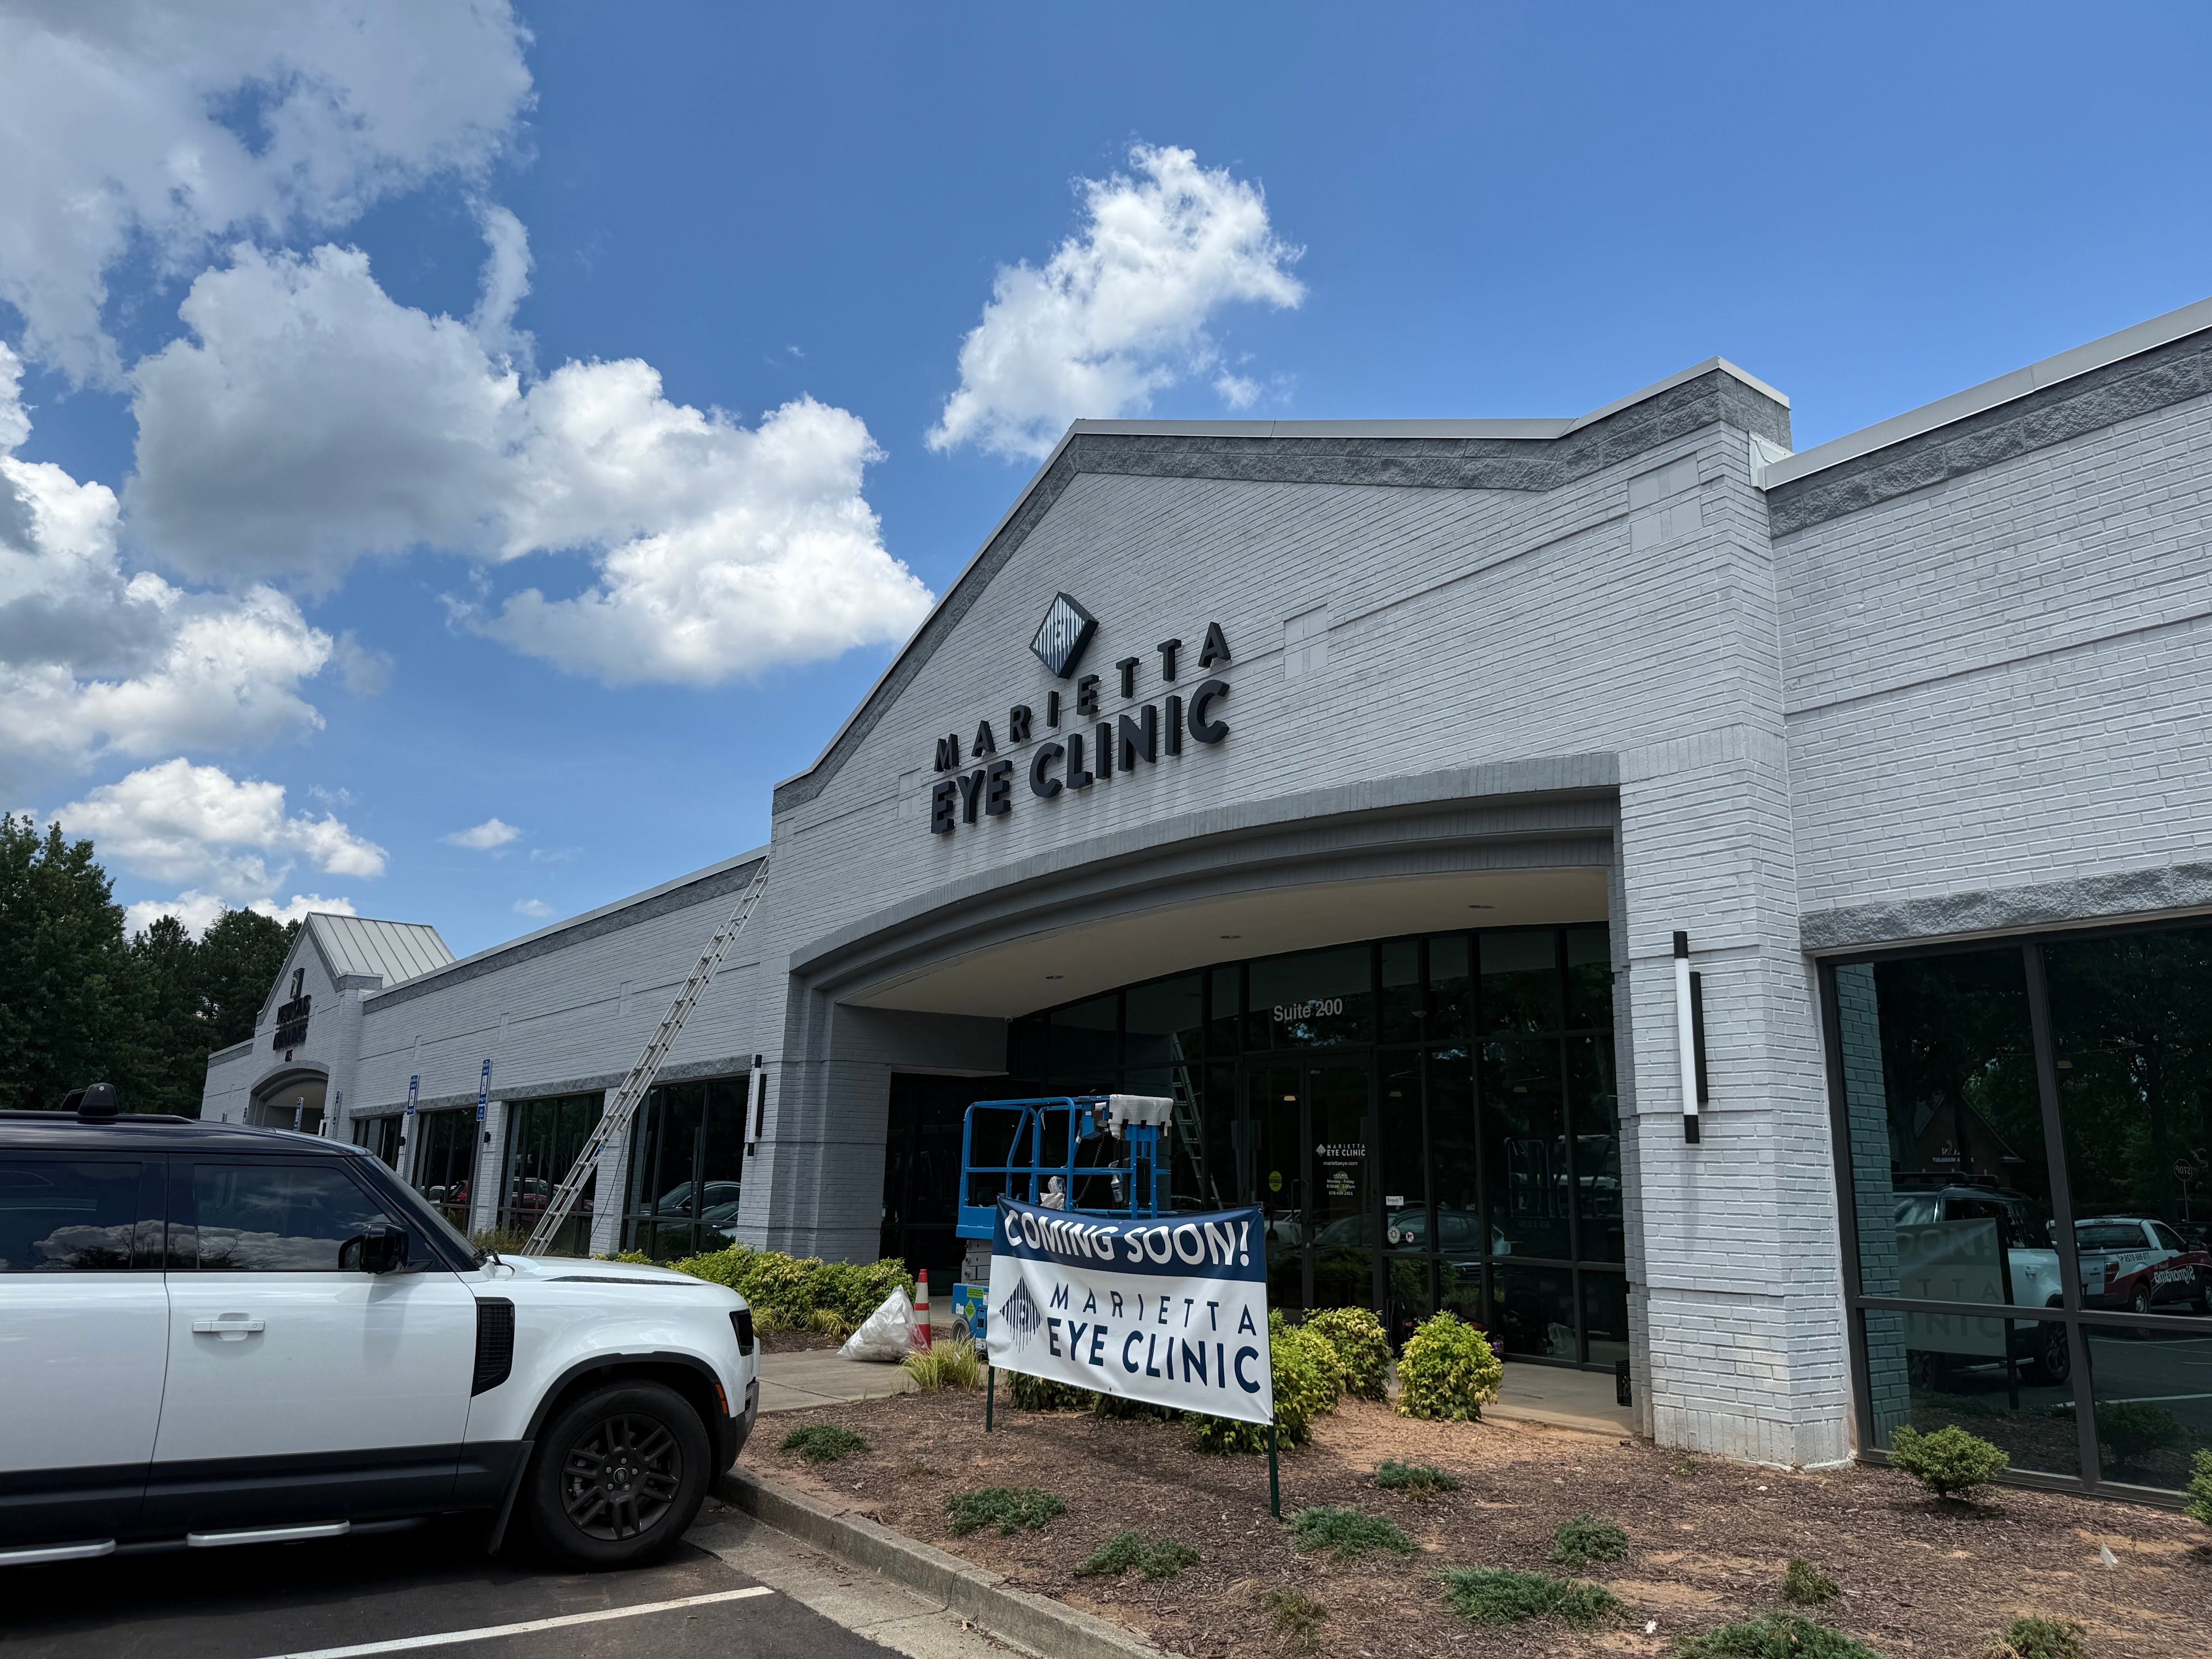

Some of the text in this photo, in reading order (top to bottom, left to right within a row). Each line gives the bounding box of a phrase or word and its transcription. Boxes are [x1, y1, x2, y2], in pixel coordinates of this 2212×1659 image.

[934, 622, 1231, 772] MARIETTA
[931, 679, 1230, 834] EYE CLINIC
[1274, 998, 1342, 1021] Suite 200
[1005, 1210, 1249, 1267] COMING SOON!
[1050, 1282, 1257, 1336] MARIETTA
[1047, 1317, 1261, 1394] EYE CLINIC
